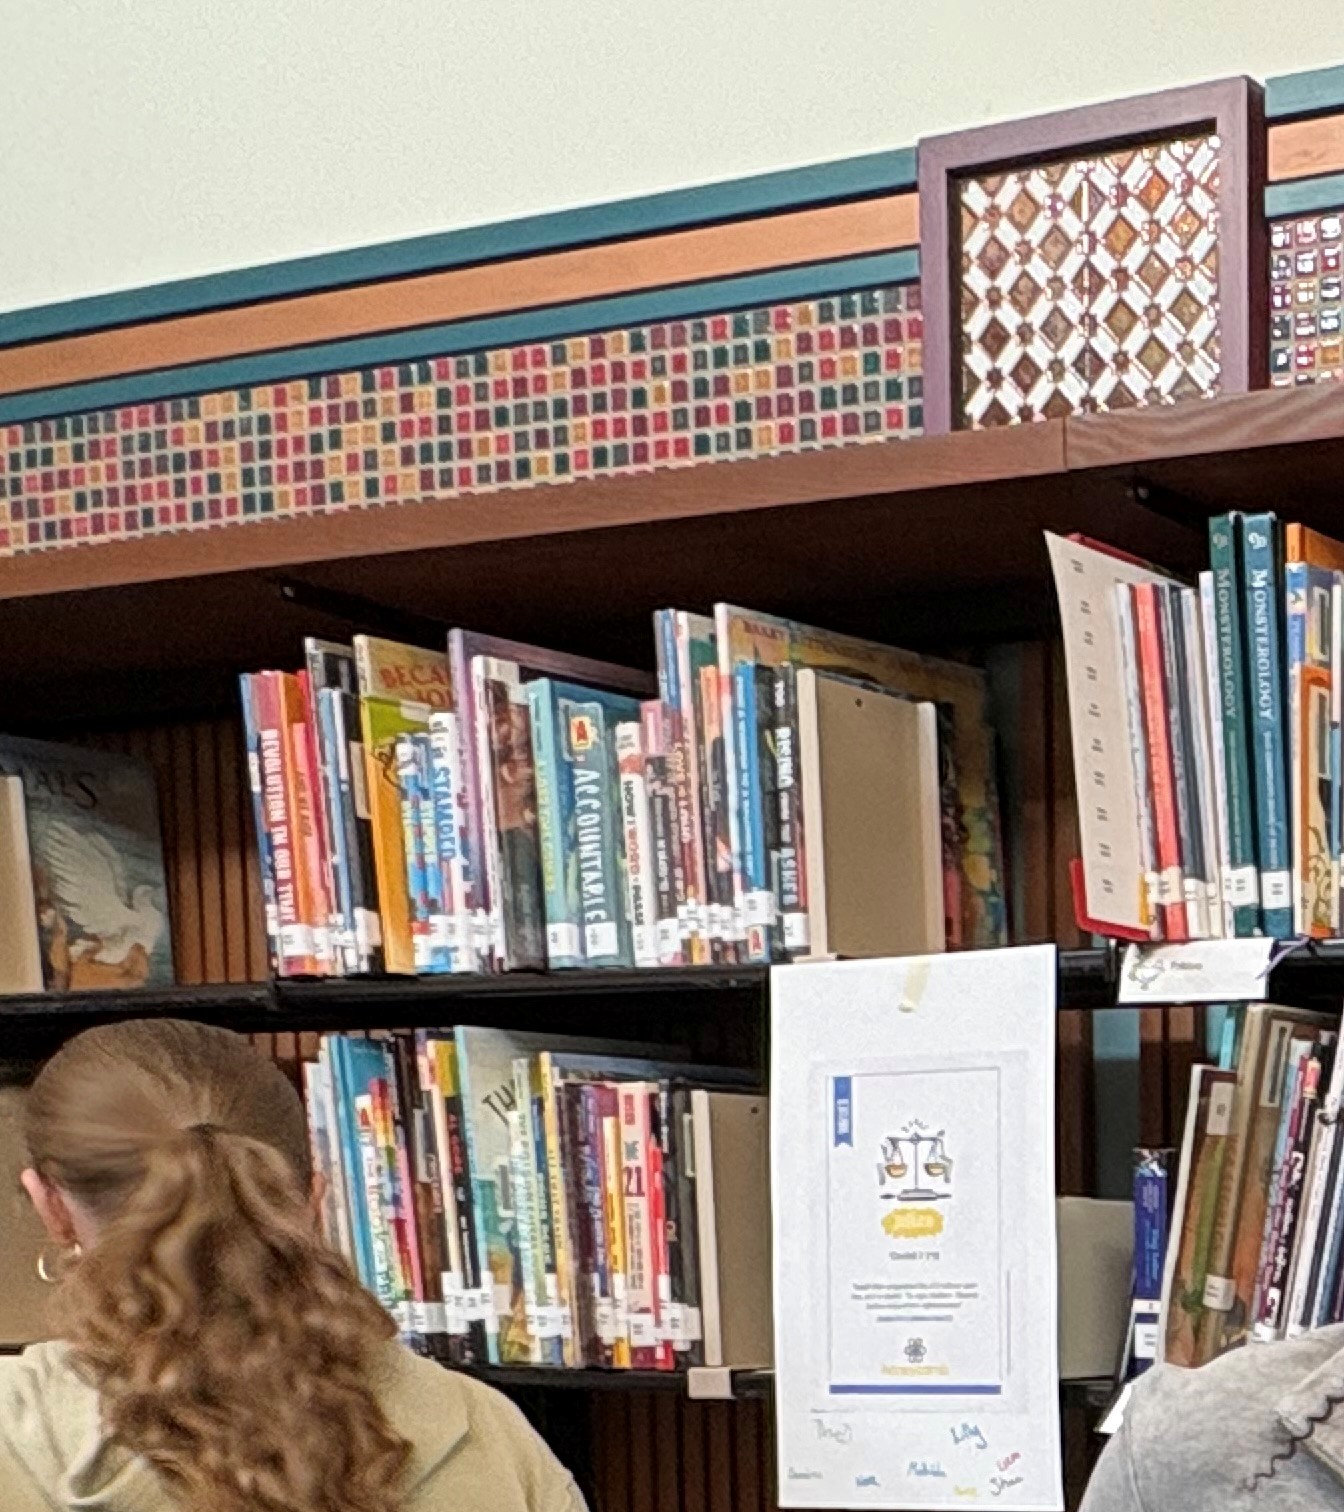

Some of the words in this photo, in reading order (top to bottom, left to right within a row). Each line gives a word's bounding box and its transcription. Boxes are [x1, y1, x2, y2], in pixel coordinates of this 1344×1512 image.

[1249, 567, 1276, 719] MONSTEROLOGY
[572, 767, 614, 922] ACCOUNTABLE
[625, 1167, 646, 1198] 21
